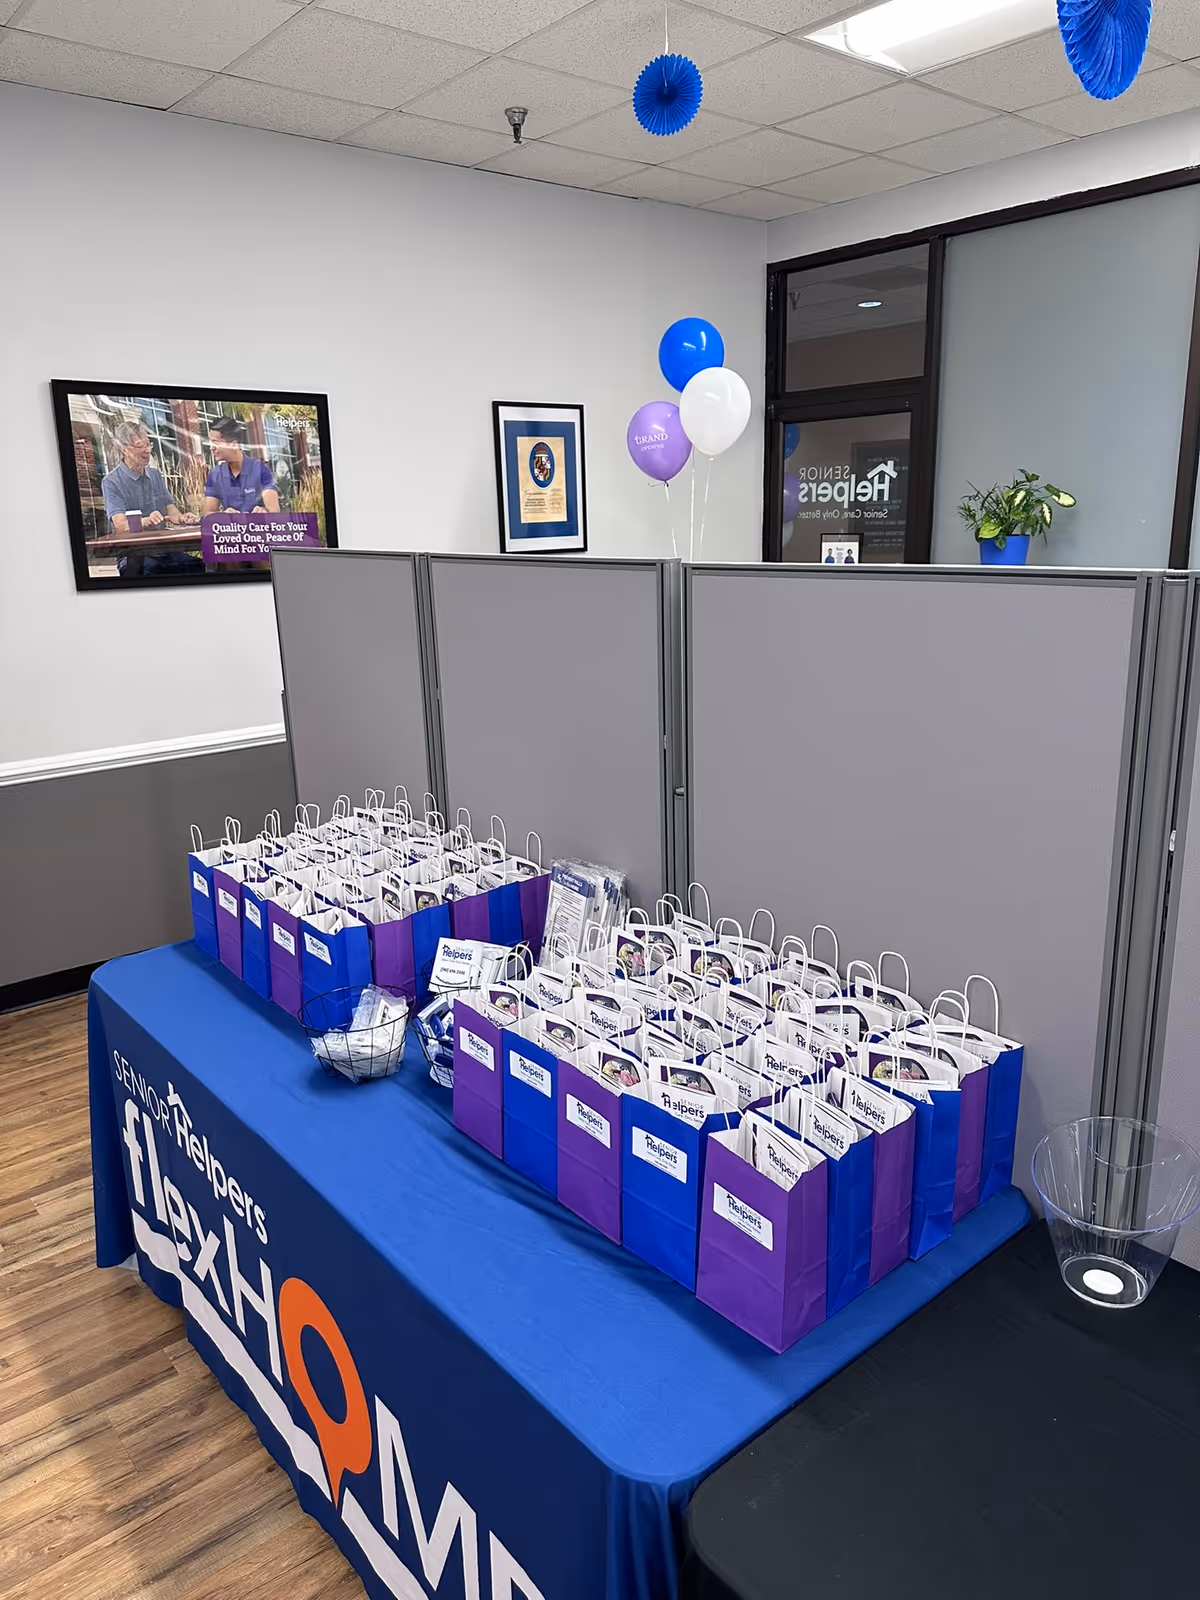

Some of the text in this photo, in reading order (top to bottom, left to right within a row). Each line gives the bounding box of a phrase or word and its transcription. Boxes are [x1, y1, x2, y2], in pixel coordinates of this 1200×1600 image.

[276, 417, 310, 429] Helpers
[634, 432, 669, 445] GRAND
[212, 521, 308, 534] Quality Care For Your
[213, 532, 304, 544] Loved One, Peace Of
[214, 543, 272, 554] Mind For Yo
[442, 948, 473, 961] Helpers
[113, 1049, 268, 1245] SENIOR Helpers
[646, 1139, 678, 1164] Helpers
[728, 1198, 762, 1230] Helpers
